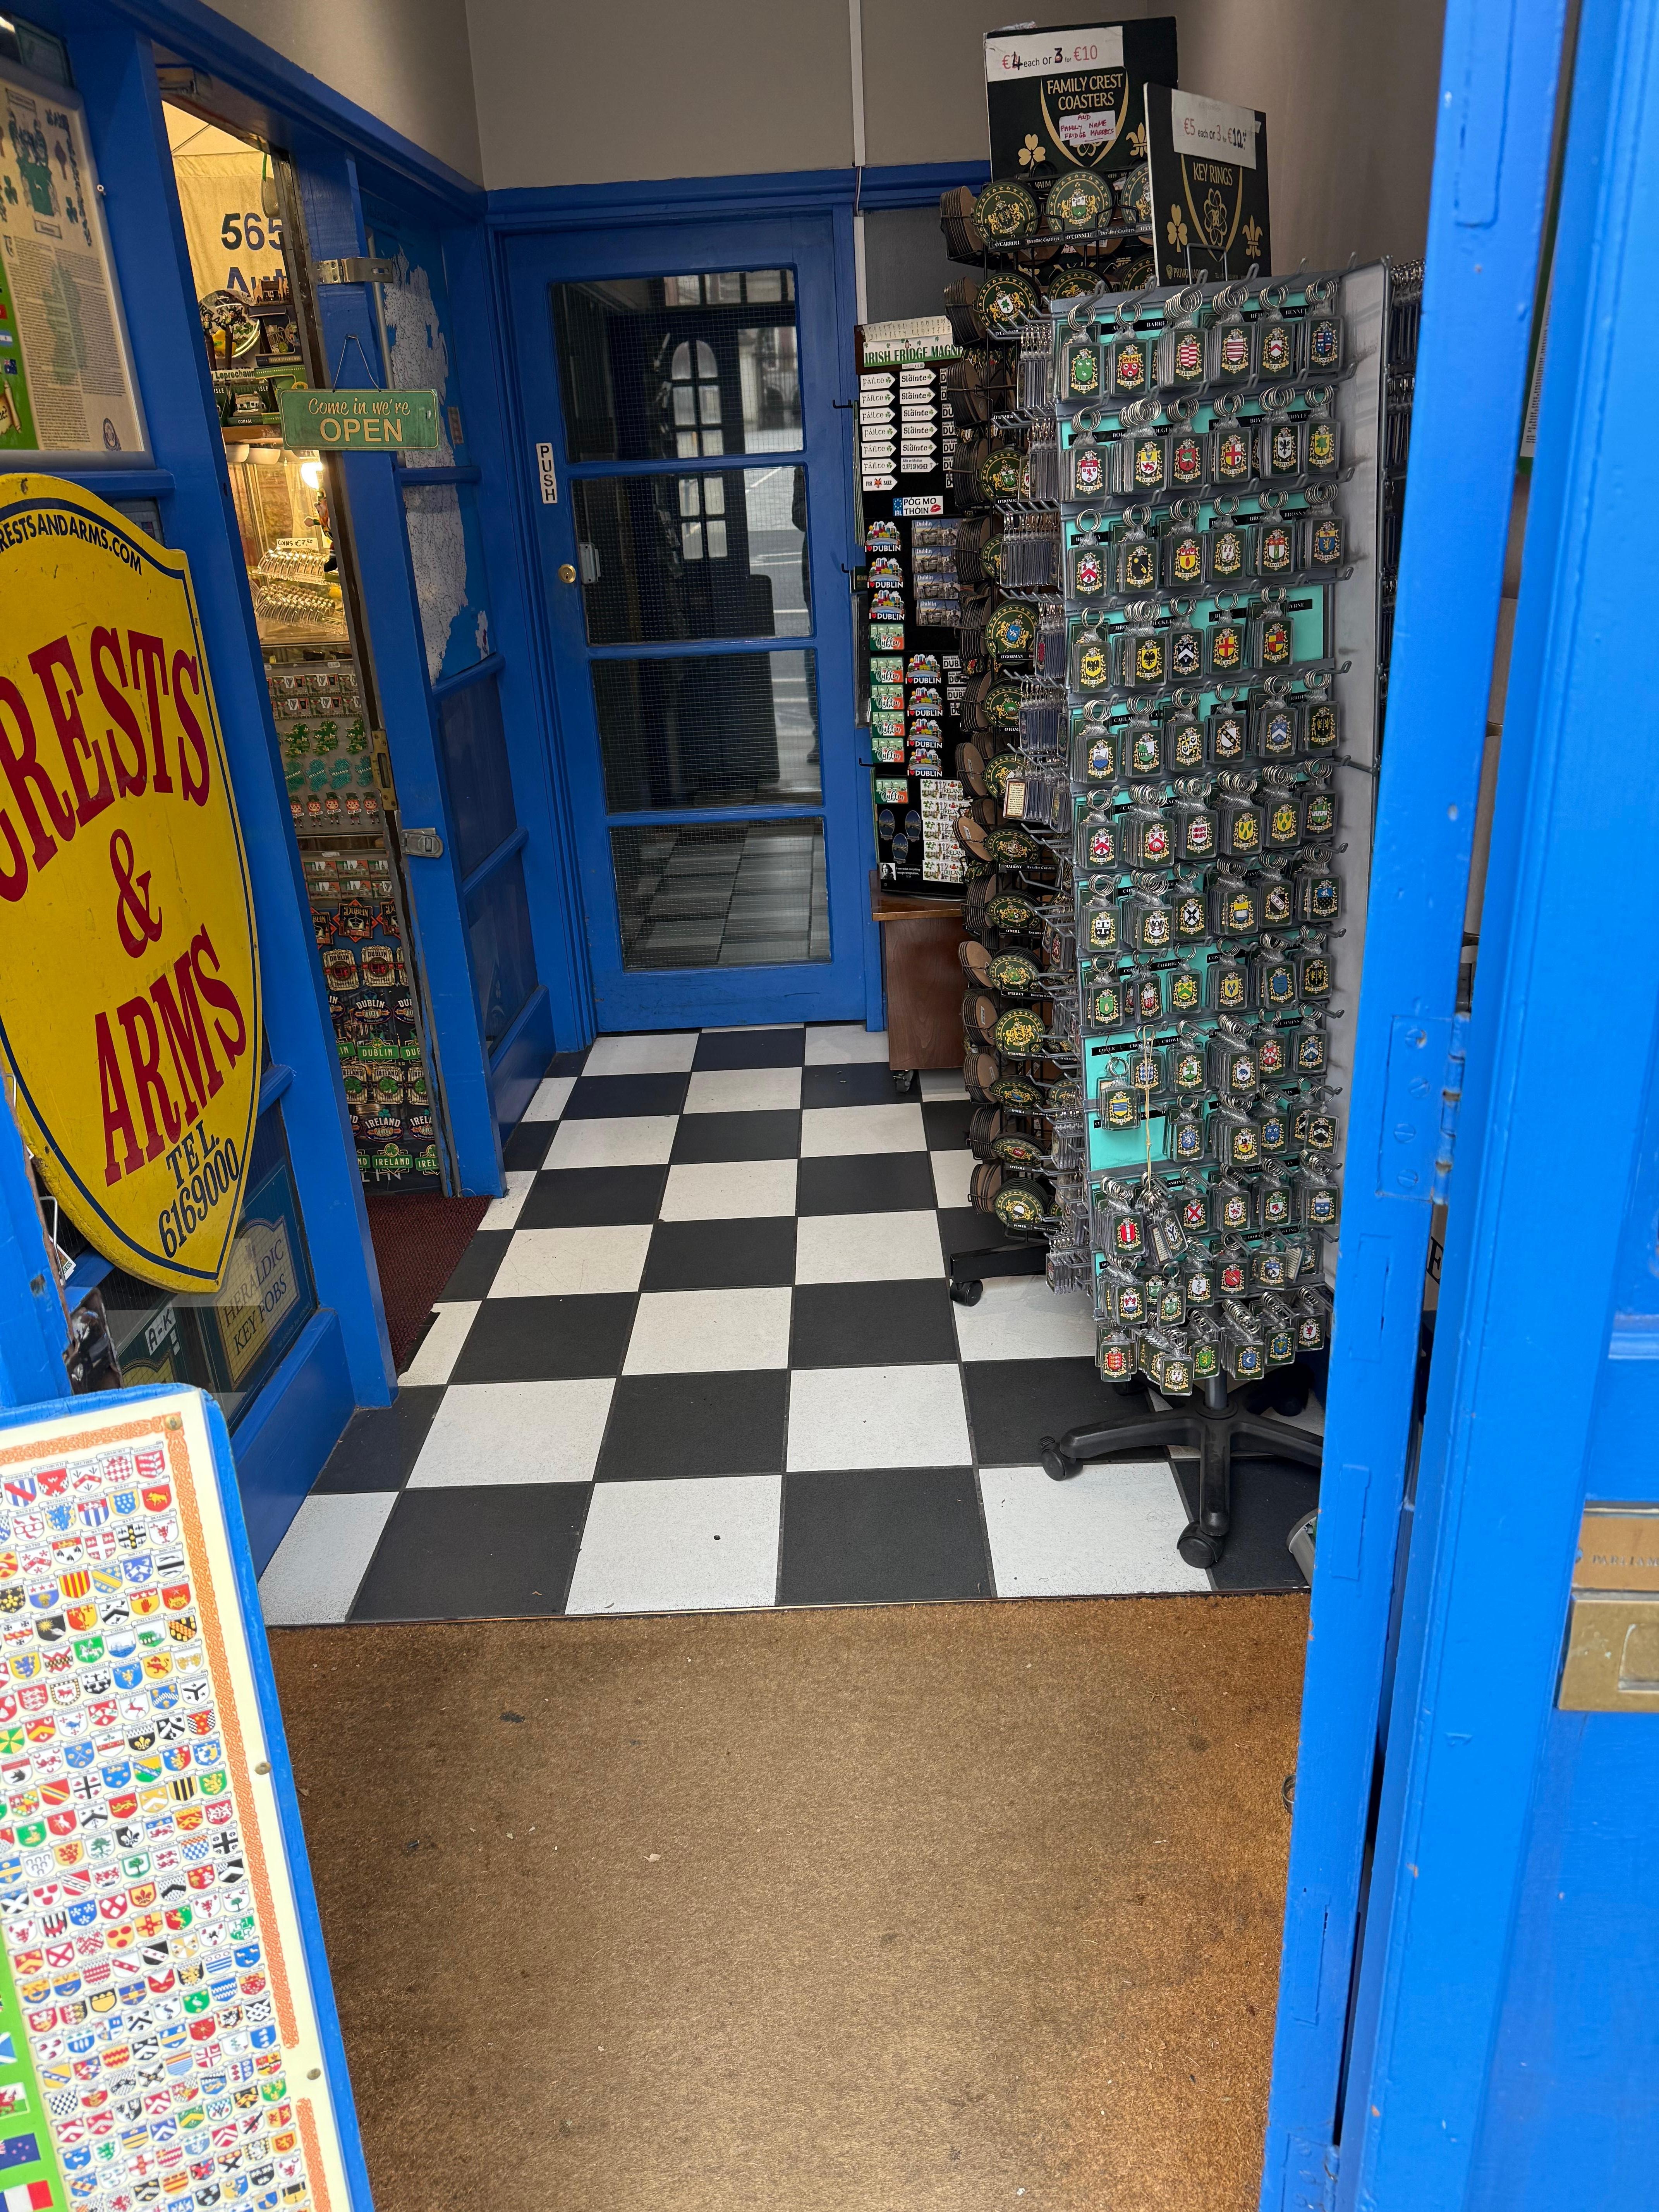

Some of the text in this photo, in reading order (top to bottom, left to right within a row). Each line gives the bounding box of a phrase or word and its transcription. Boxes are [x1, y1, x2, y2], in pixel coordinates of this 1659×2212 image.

[1024, 58, 1040, 67] each
[1042, 57, 1052, 65] or
[1054, 47, 1063, 63] 3
[1073, 45, 1097, 61] €10
[1047, 73, 1123, 94] FAMILY CREST
[1058, 91, 1115, 111] COASTERS
[1089, 120, 1106, 129] NAME
[1184, 117, 1195, 135] €5
[1198, 130, 1208, 139] each
[1209, 130, 1215, 140] or
[1216, 124, 1221, 141] 3
[1193, 162, 1233, 186] KEY RINGS
[865, 344, 963, 364] IRISH FRIDGE MAGNE
[902, 374, 926, 382] Sláinte
[309, 397, 410, 416] Come in we're
[320, 418, 403, 442] OPEN
[540, 445, 555, 501] PUSH
[904, 497, 921, 505] PÓG
[0, 514, 142, 576] RESTSANDARMS.COM
[110, 828, 162, 958] &
[313, 915, 326, 924] BLIN
[343, 906, 368, 917] DUBLIN
[356, 1000, 385, 1010] DUBLIN
[95, 923, 246, 1187] ARMS
[362, 1049, 393, 1057] DUBLIN
[405, 1048, 420, 1057] DUB
[365, 1117, 400, 1128] IRELAND
[167, 1120, 220, 1189] TEL.
[158, 1137, 239, 1258] 6169000
[223, 1238, 284, 1328] HERALDIC
[233, 1274, 287, 1356] KEY FOBS
[1592, 1554, 1659, 1567] PARLIAM
